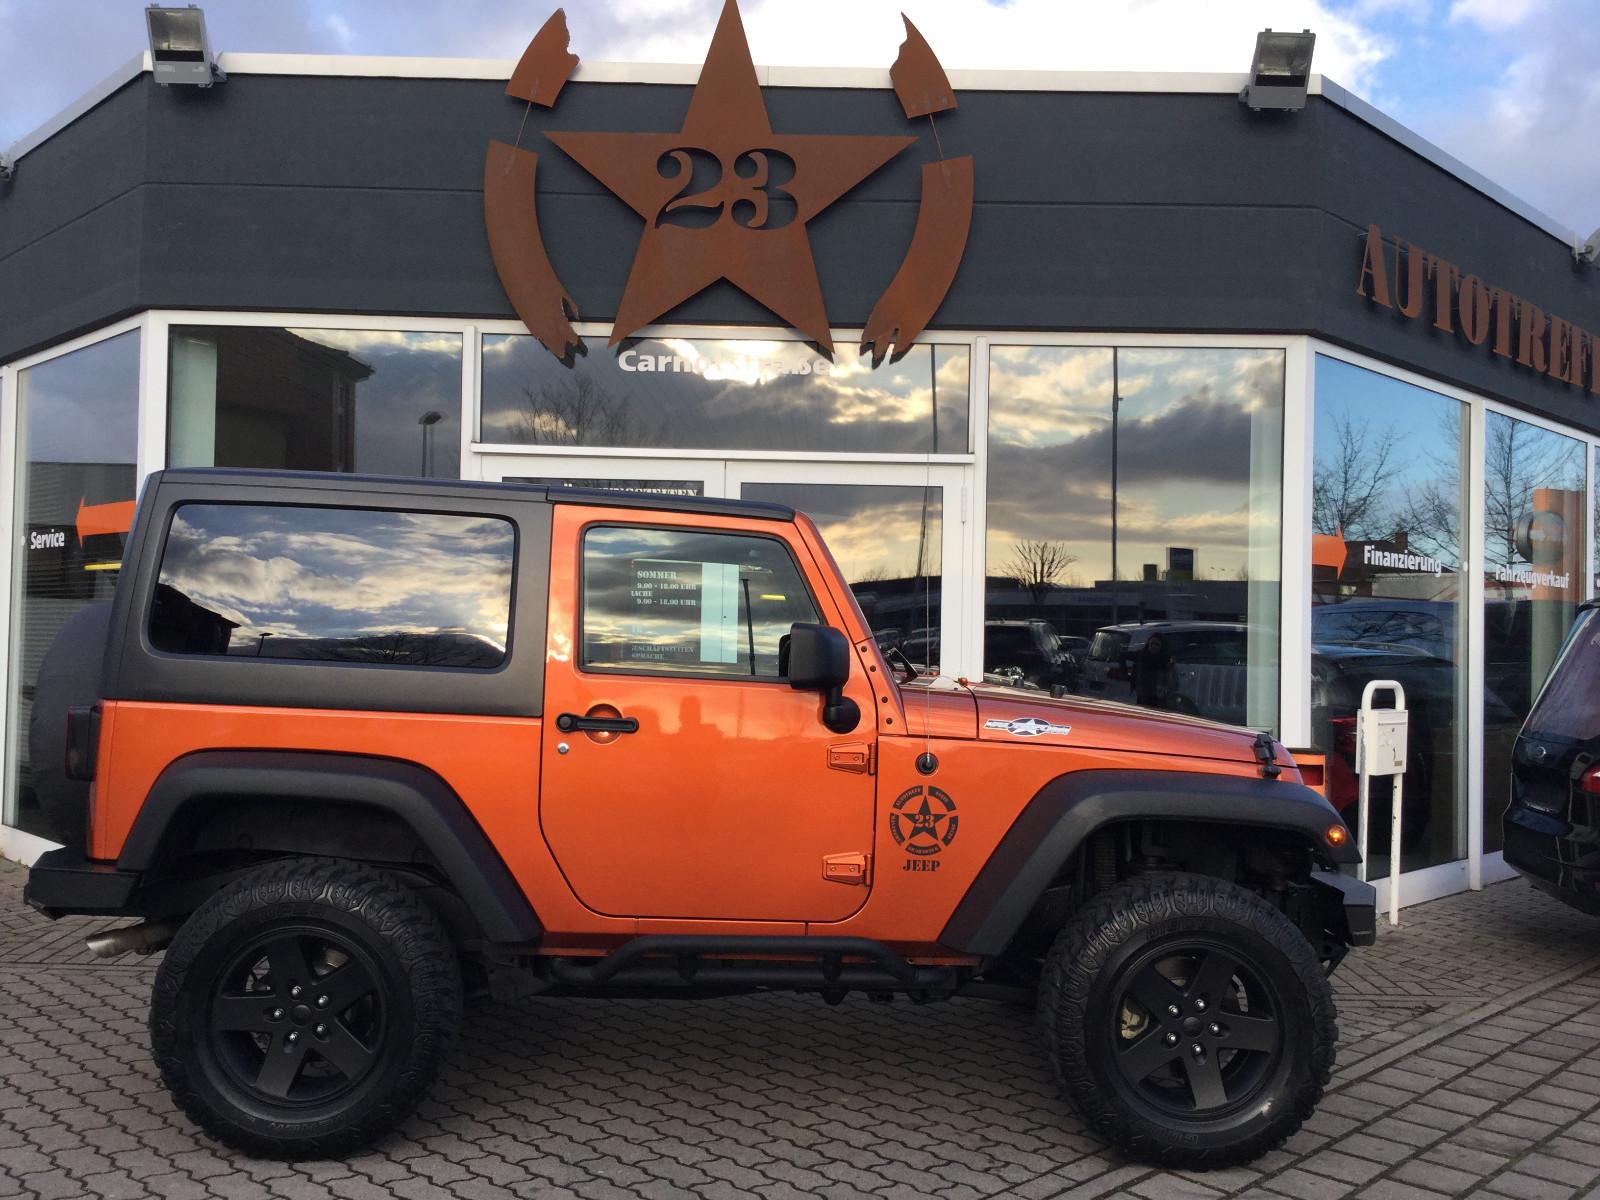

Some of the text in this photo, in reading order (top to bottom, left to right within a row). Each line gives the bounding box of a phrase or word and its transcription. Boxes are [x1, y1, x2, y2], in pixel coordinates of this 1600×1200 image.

[655, 146, 799, 230] 23
[30, 529, 65, 549] Service
[1364, 545, 1442, 577] Finanzierung
[637, 571, 677, 579] SOMMER
[1495, 563, 1570, 589] Fahrzeugverkauf
[915, 814, 935, 828] 23
[902, 859, 941, 872] JEEP
